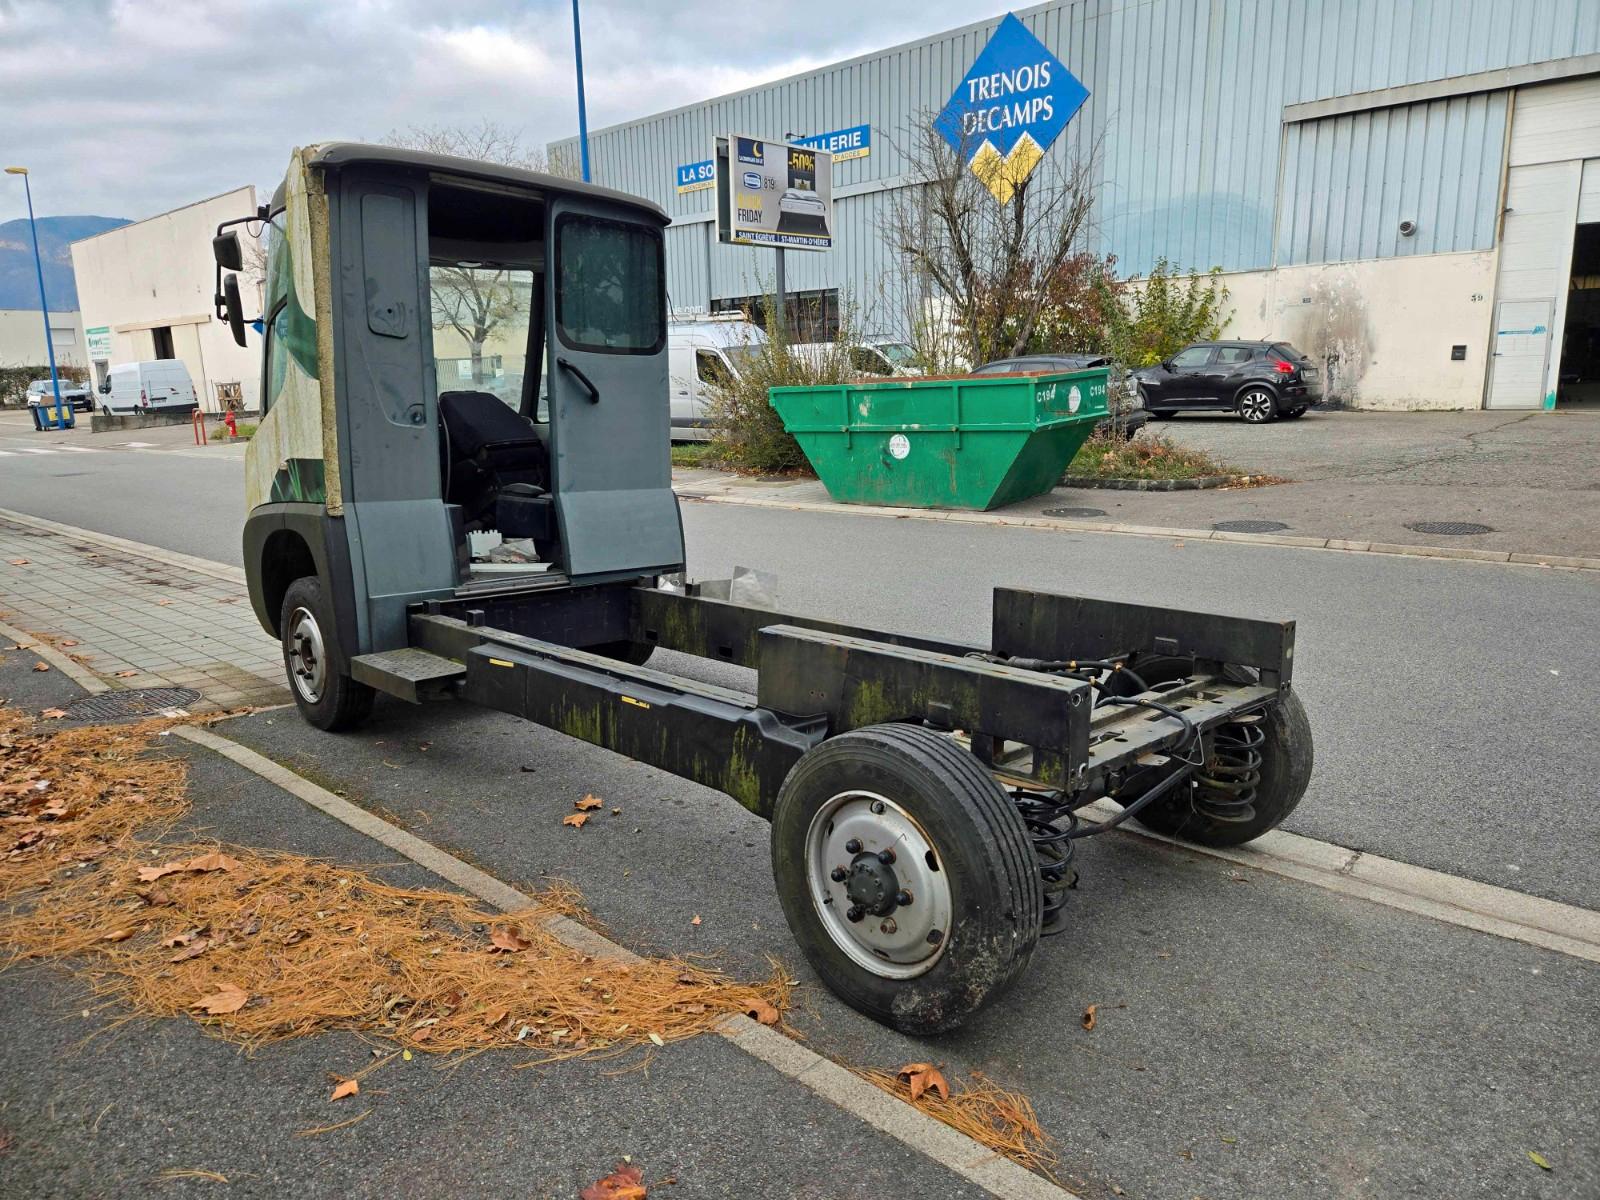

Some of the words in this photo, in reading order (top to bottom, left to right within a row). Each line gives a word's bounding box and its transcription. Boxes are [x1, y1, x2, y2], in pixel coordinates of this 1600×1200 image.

[967, 61, 1051, 103] TRENOIS
[963, 95, 1054, 136] DECAMPS
[682, 168, 696, 182] LA
[698, 164, 714, 179] SO
[738, 208, 763, 224] FRIDAY
[738, 231, 756, 240] SAINT
[1036, 386, 1056, 403] C194
[1089, 385, 1106, 397] C194
